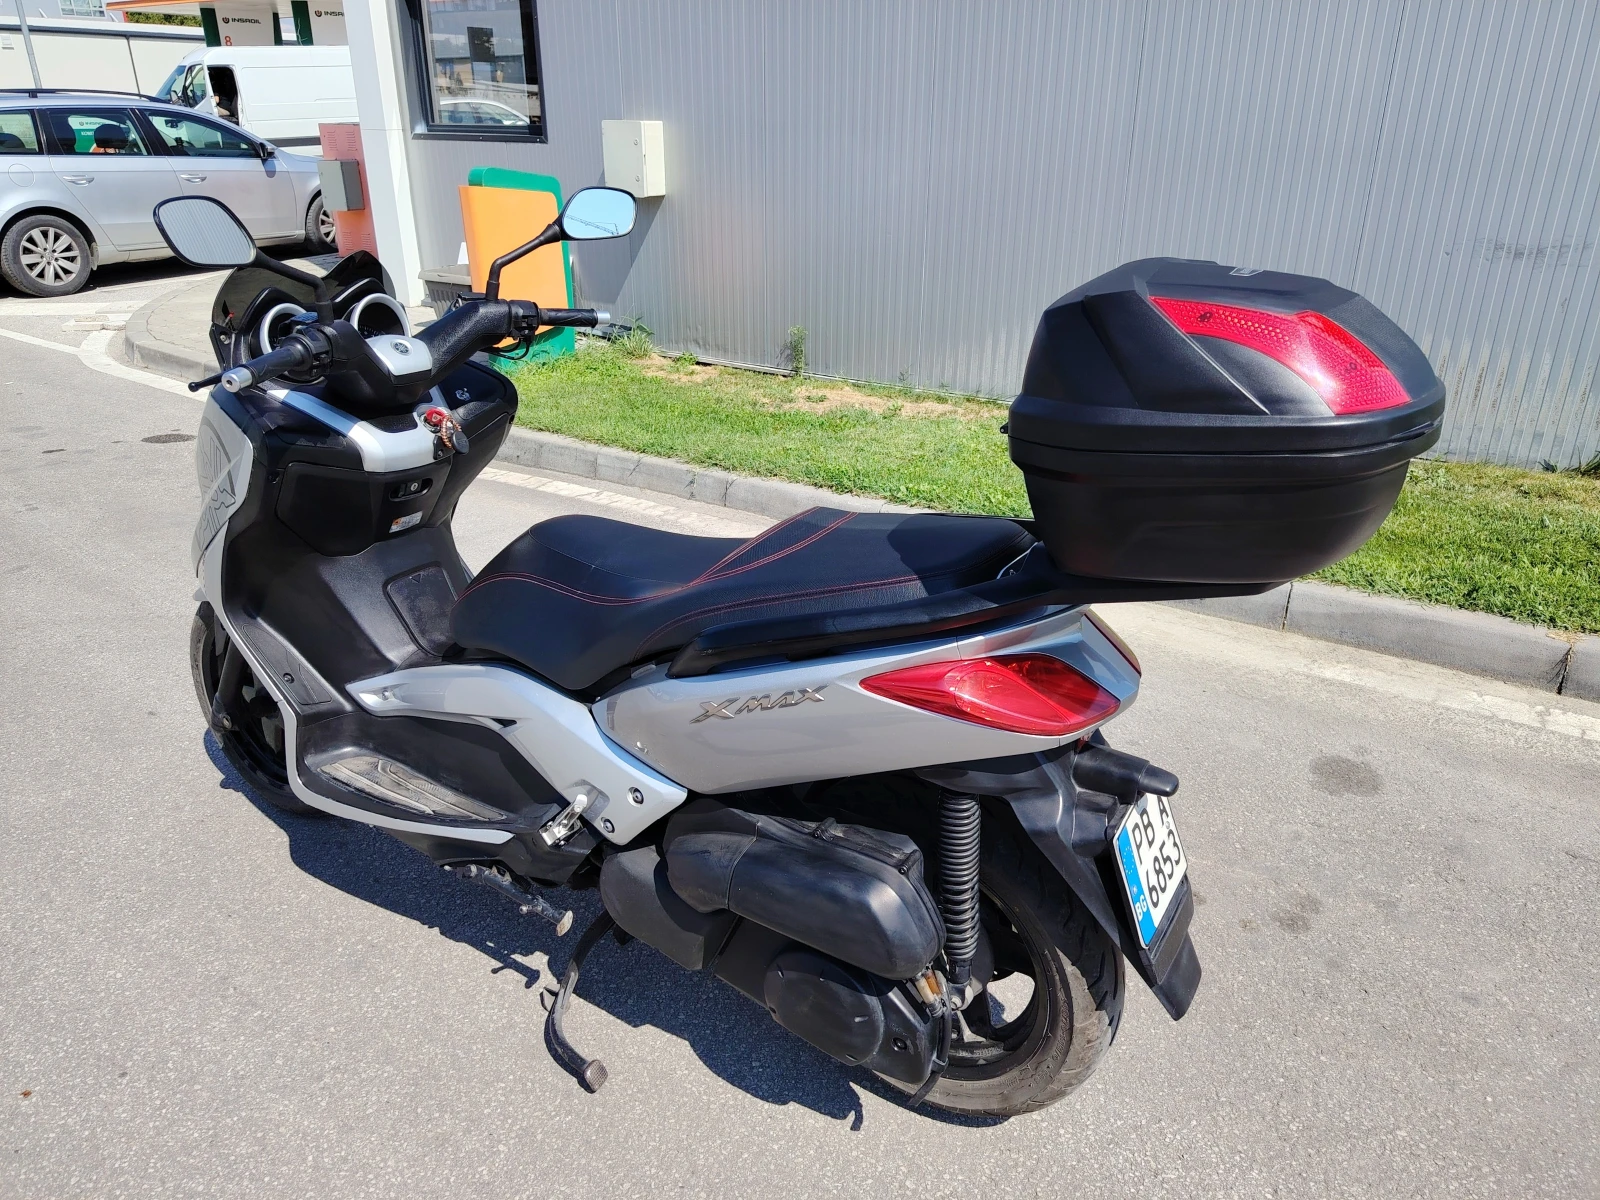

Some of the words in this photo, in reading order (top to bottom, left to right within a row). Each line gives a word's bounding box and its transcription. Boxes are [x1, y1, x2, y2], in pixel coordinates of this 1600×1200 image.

[224, 35, 233, 46] 8
[1131, 807, 1156, 866] PB
[1157, 795, 1169, 826] A
[1145, 828, 1181, 909] 6853
[1135, 894, 1148, 921] BG
